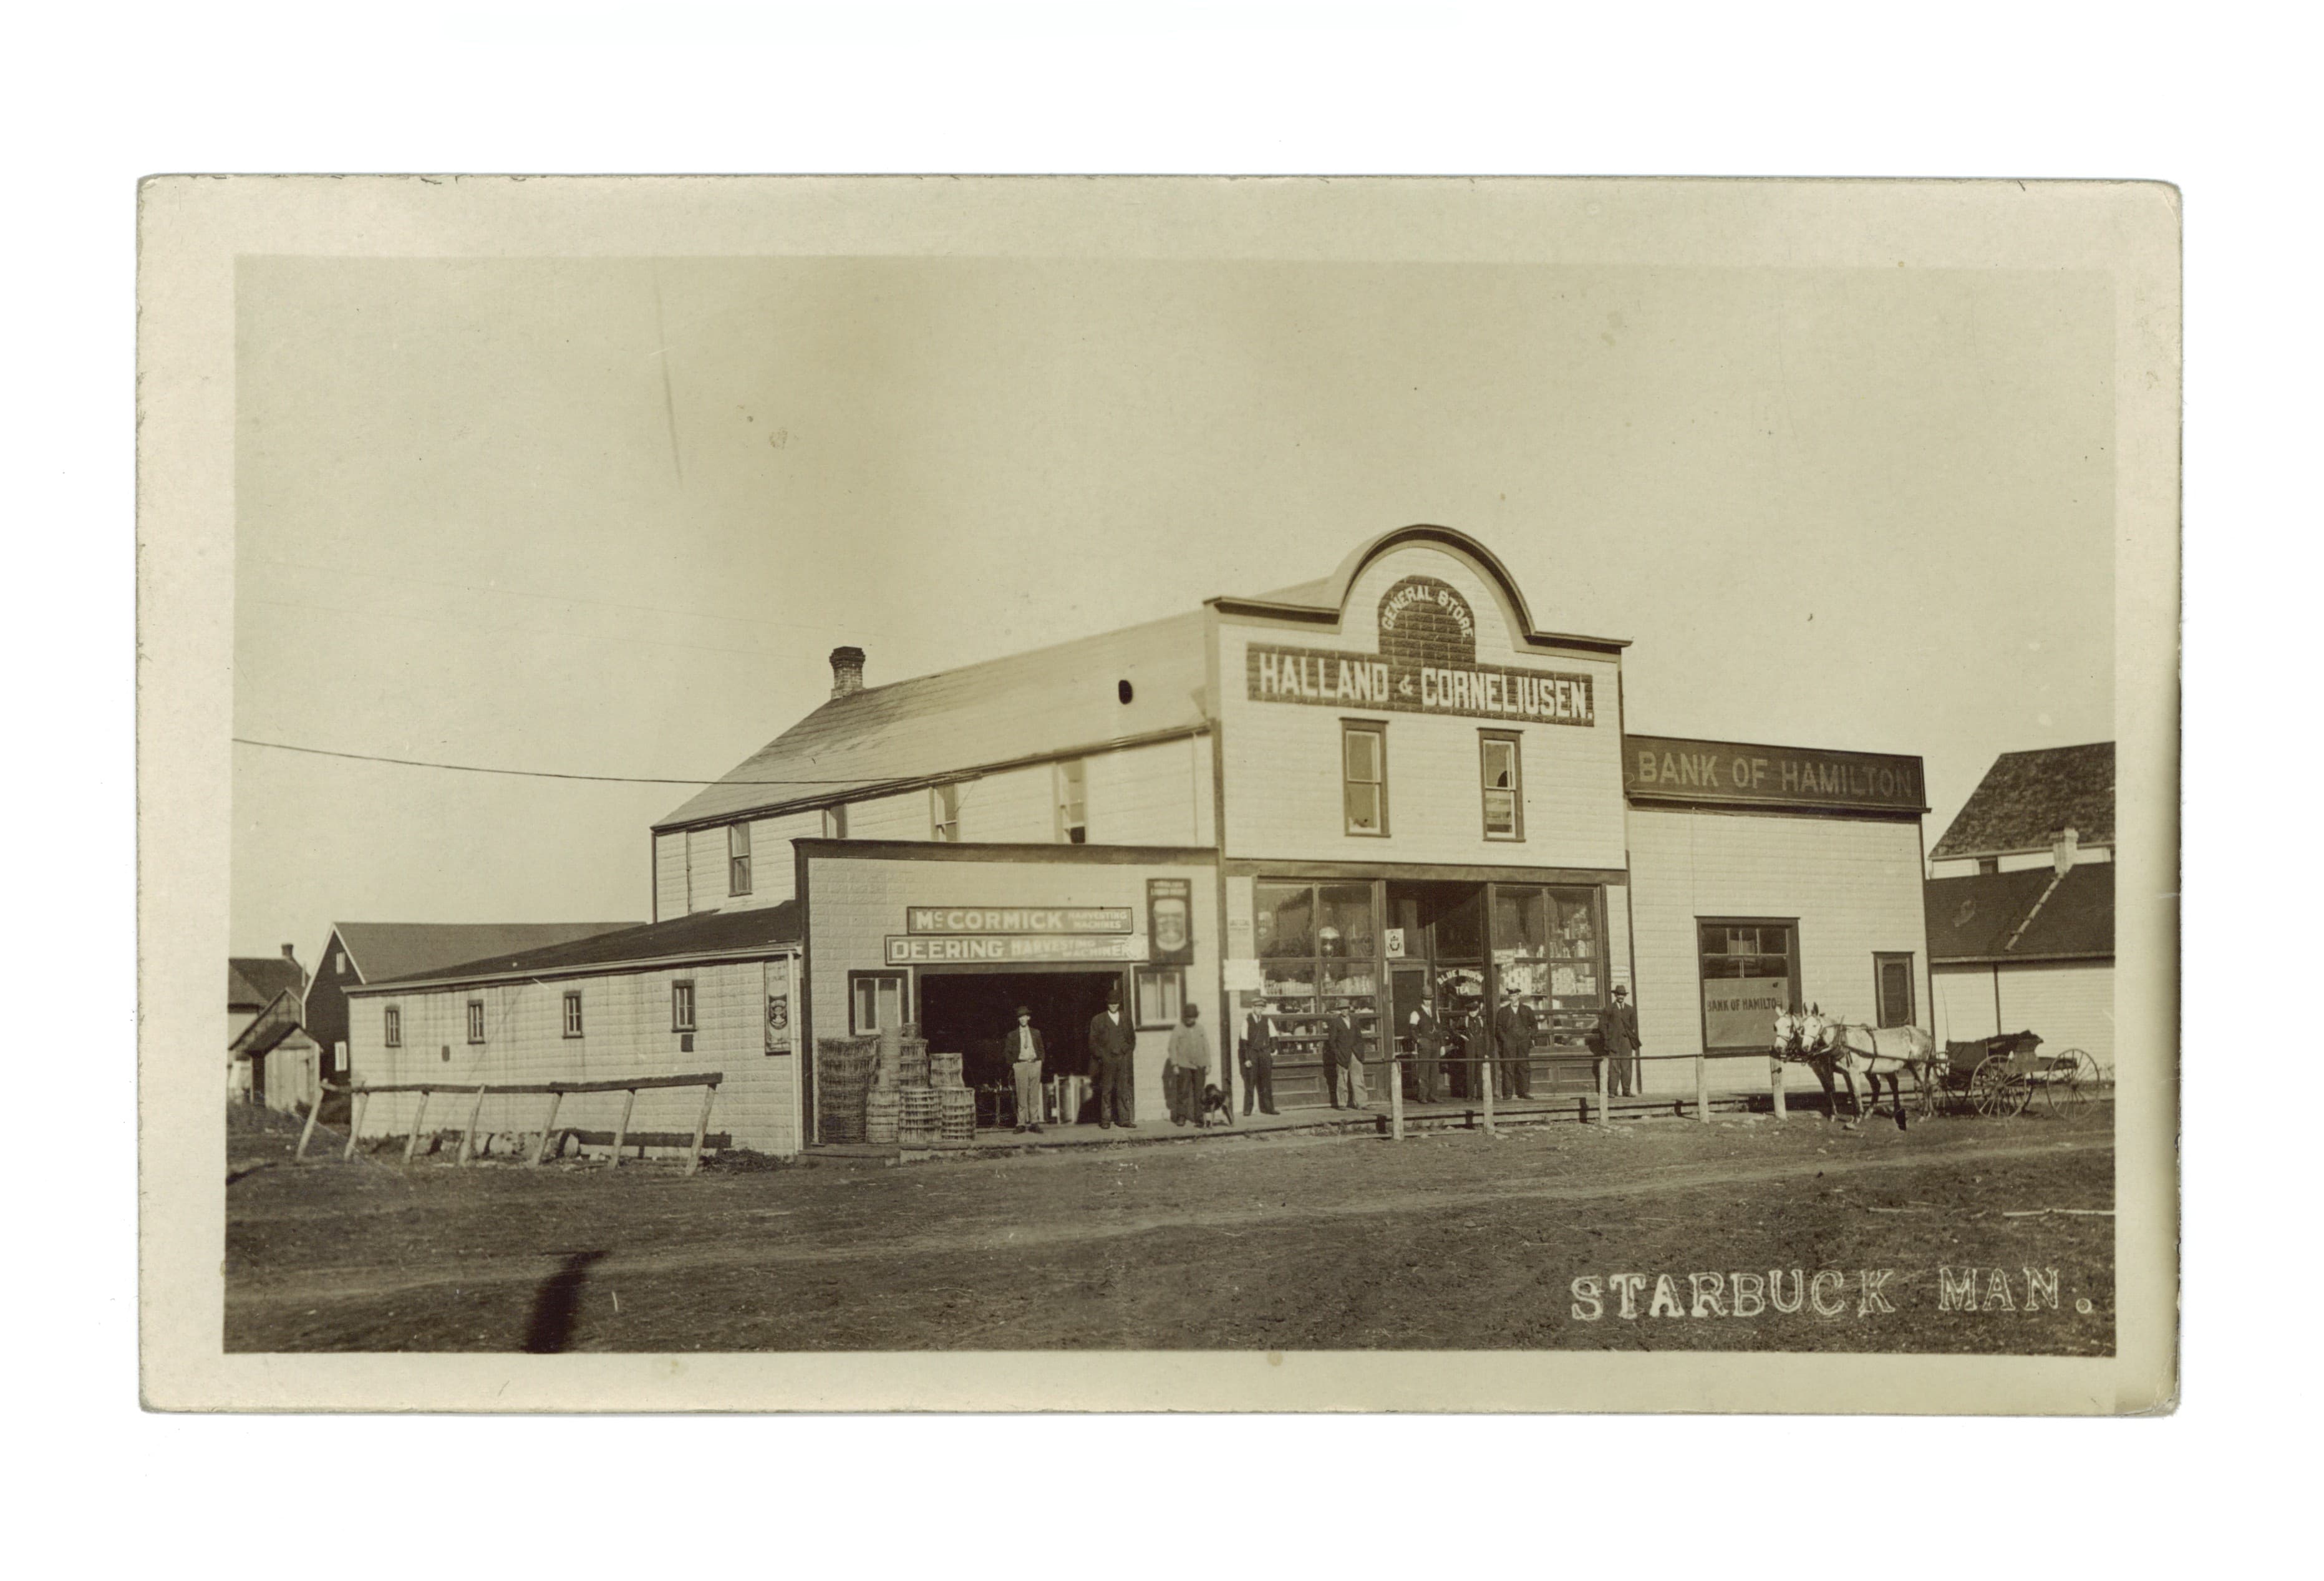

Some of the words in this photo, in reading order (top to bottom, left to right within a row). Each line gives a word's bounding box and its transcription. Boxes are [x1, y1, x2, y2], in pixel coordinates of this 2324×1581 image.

[1381, 585, 1433, 631] GENERAL
[1437, 590, 1474, 638] STORE
[1259, 653, 1388, 703] HALLAND
[1398, 674, 1413, 696] &
[1420, 666, 1593, 719] CORNELIUSEN.
[1637, 751, 1719, 788] BANK
[1731, 757, 1768, 789] OF
[1780, 760, 1912, 798] HAMILTON
[891, 940, 1004, 959] DEERING
[1436, 969, 1458, 985] BLUE
[1455, 986, 1471, 996] TEA
[1707, 999, 1729, 1012] BANK
[1730, 998, 1740, 1011] OF
